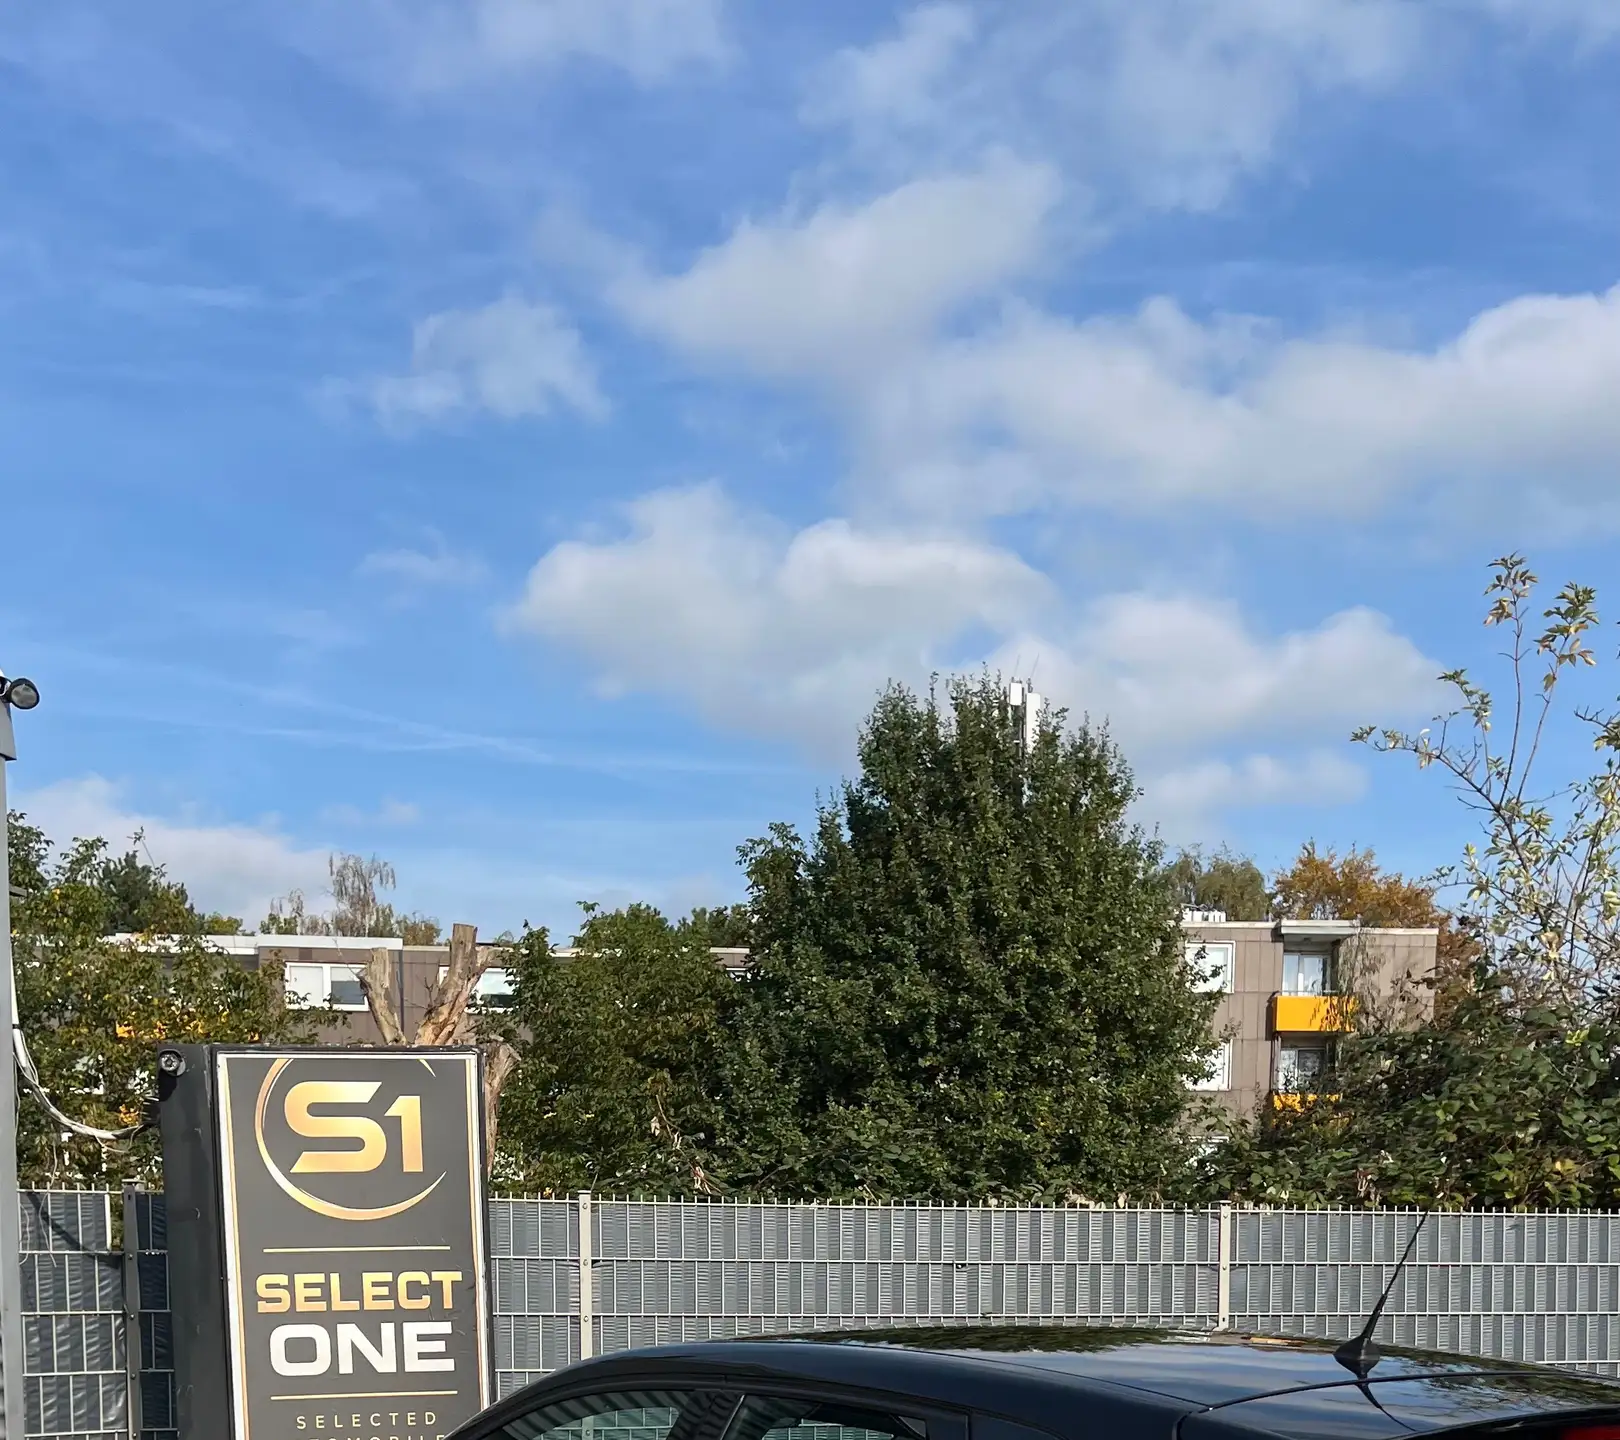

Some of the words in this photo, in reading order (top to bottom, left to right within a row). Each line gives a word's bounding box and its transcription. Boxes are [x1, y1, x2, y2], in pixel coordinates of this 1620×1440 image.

[284, 1081, 424, 1173] S1
[256, 1271, 463, 1312] SELECT
[270, 1322, 455, 1376] ONE
[296, 1411, 437, 1430] SELECTED
